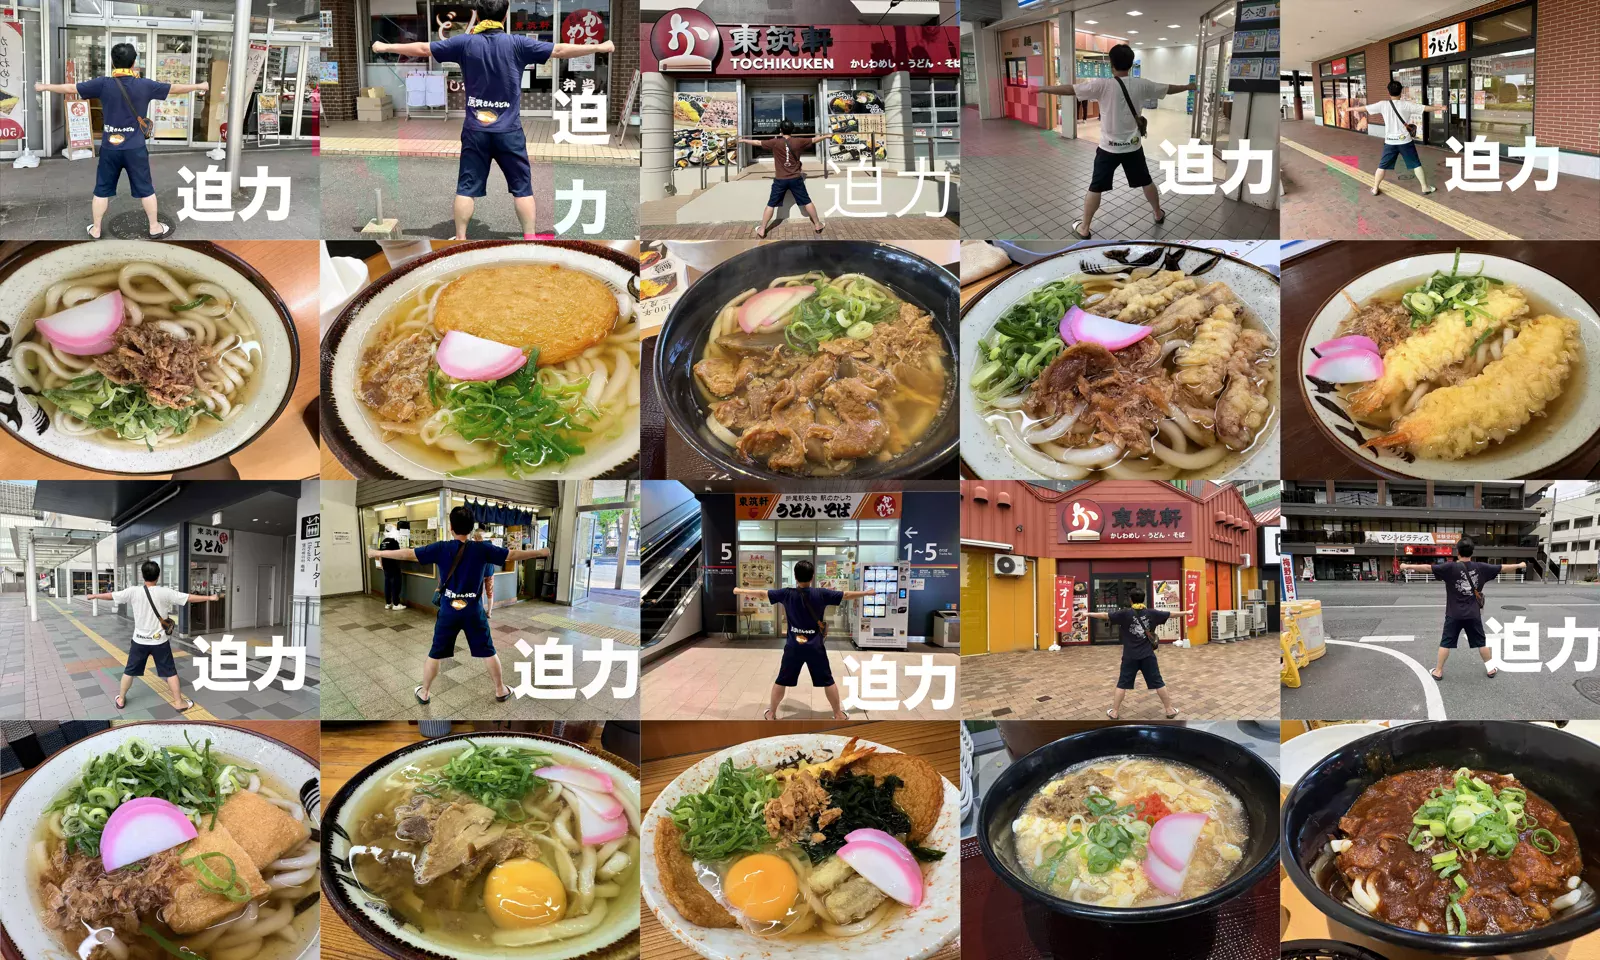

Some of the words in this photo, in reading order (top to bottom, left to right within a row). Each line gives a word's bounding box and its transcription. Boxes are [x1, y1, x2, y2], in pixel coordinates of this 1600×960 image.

[515, 21, 550, 30] 東筑軒
[730, 24, 834, 56] 東筑軒
[1429, 33, 1458, 55] うどん
[730, 58, 834, 70] TOCHIKUKEN
[739, 496, 769, 506] 東筑軒
[776, 502, 851, 518] うどん・そば
[1111, 506, 1182, 529] 東筑軒
[198, 527, 219, 537] 東筑軒
[193, 538, 223, 554] うどん
[721, 543, 732, 561] 5
[1057, 587, 1069, 628] オープン
